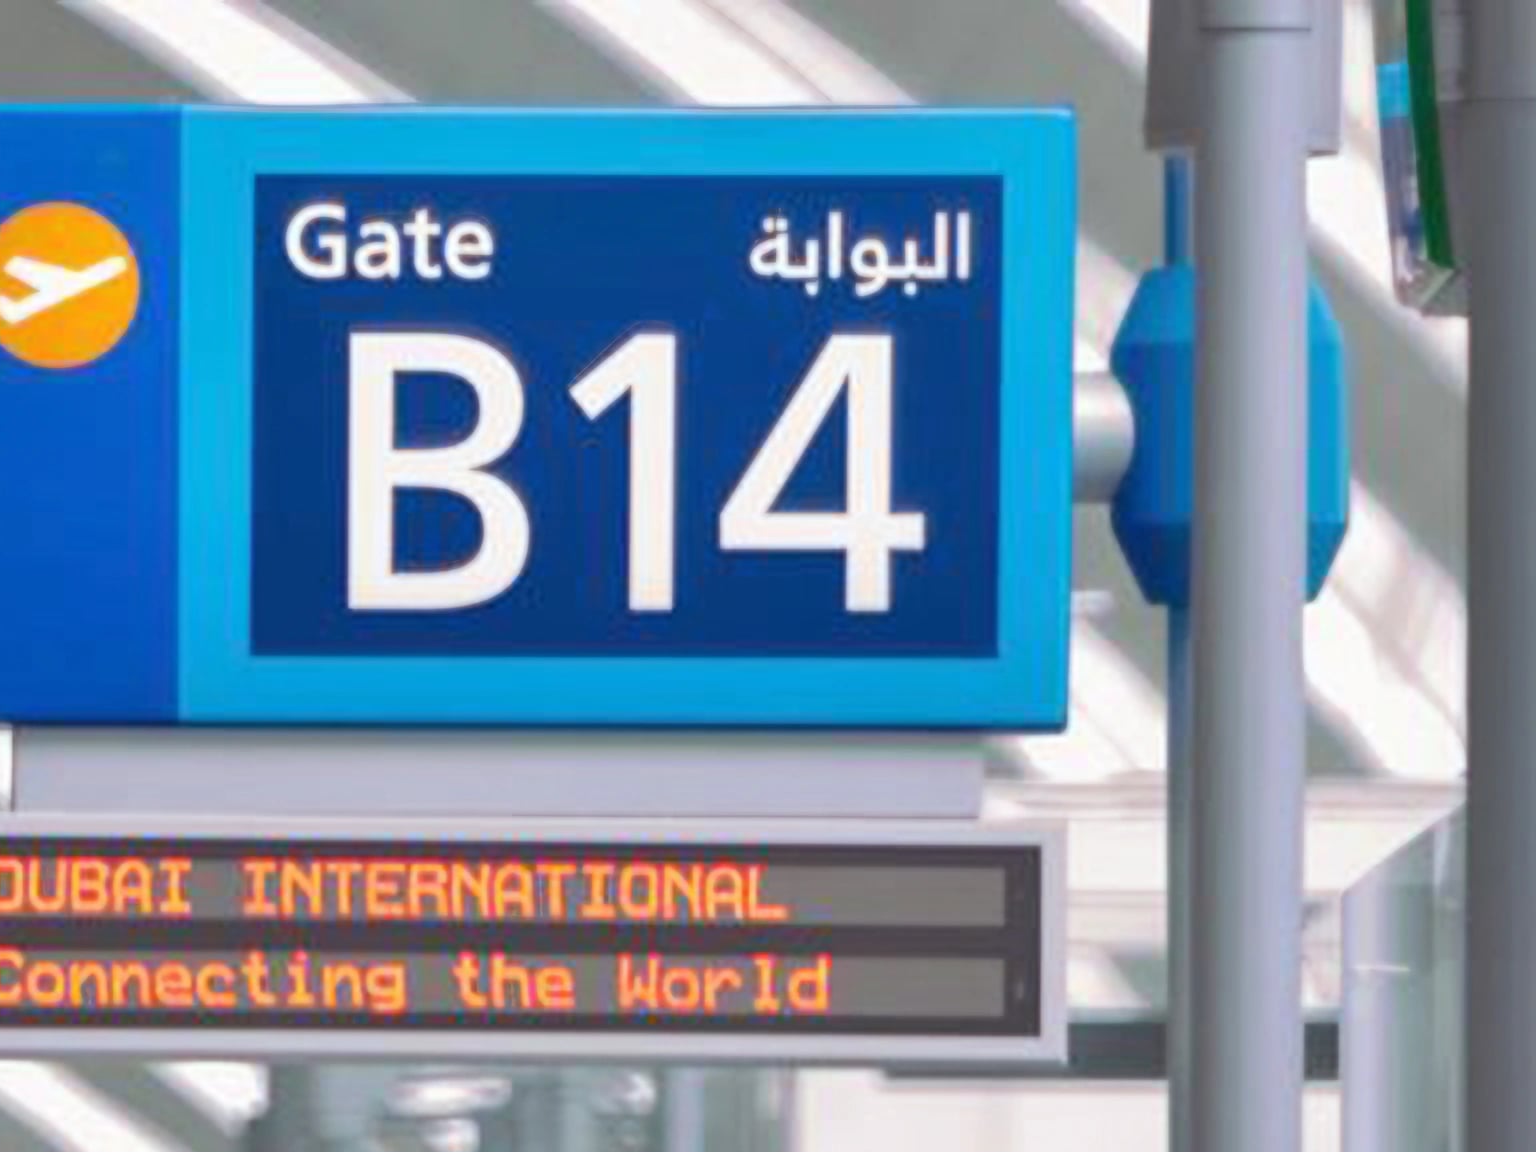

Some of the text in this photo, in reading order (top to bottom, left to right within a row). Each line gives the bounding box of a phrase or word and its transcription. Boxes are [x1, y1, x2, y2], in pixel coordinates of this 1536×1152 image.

[285, 201, 495, 281] Gate
[748, 209, 973, 296] البوابة
[346, 330, 926, 613] B14
[242, 856, 790, 922] INTERNATIONAL
[451, 950, 577, 1010] the
[616, 951, 834, 1015] World
